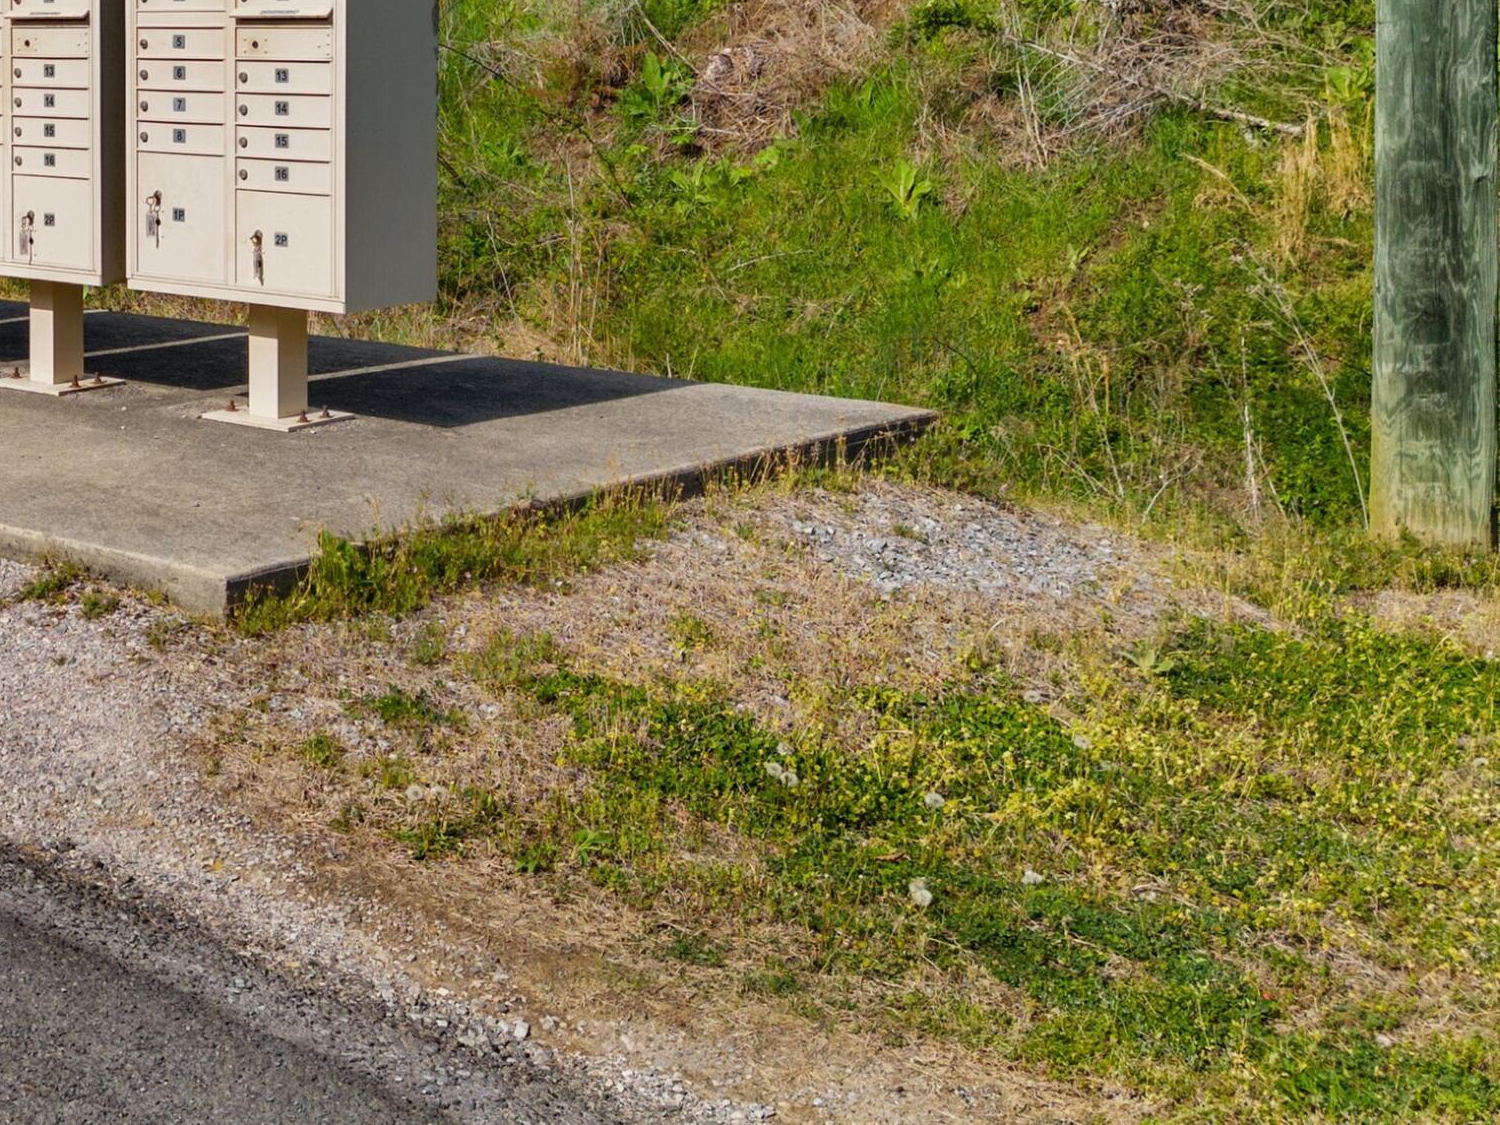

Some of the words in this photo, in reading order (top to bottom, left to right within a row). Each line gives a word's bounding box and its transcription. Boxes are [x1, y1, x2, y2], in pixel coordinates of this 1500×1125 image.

[176, 36, 182, 47] 5
[44, 66, 54, 77] 13
[176, 67, 183, 79] 6
[276, 70, 288, 81] 13
[45, 95, 55, 106] 14
[176, 98, 183, 110] 7
[276, 103, 288, 113] 14
[45, 125, 54, 136] 15
[176, 130, 183, 141] 8
[276, 136, 288, 147] 15
[45, 155, 55, 165] 16
[276, 169, 288, 180] 16
[44, 215, 55, 225] 2P
[174, 209, 185, 220] 1P
[275, 234, 288, 245] 2P
